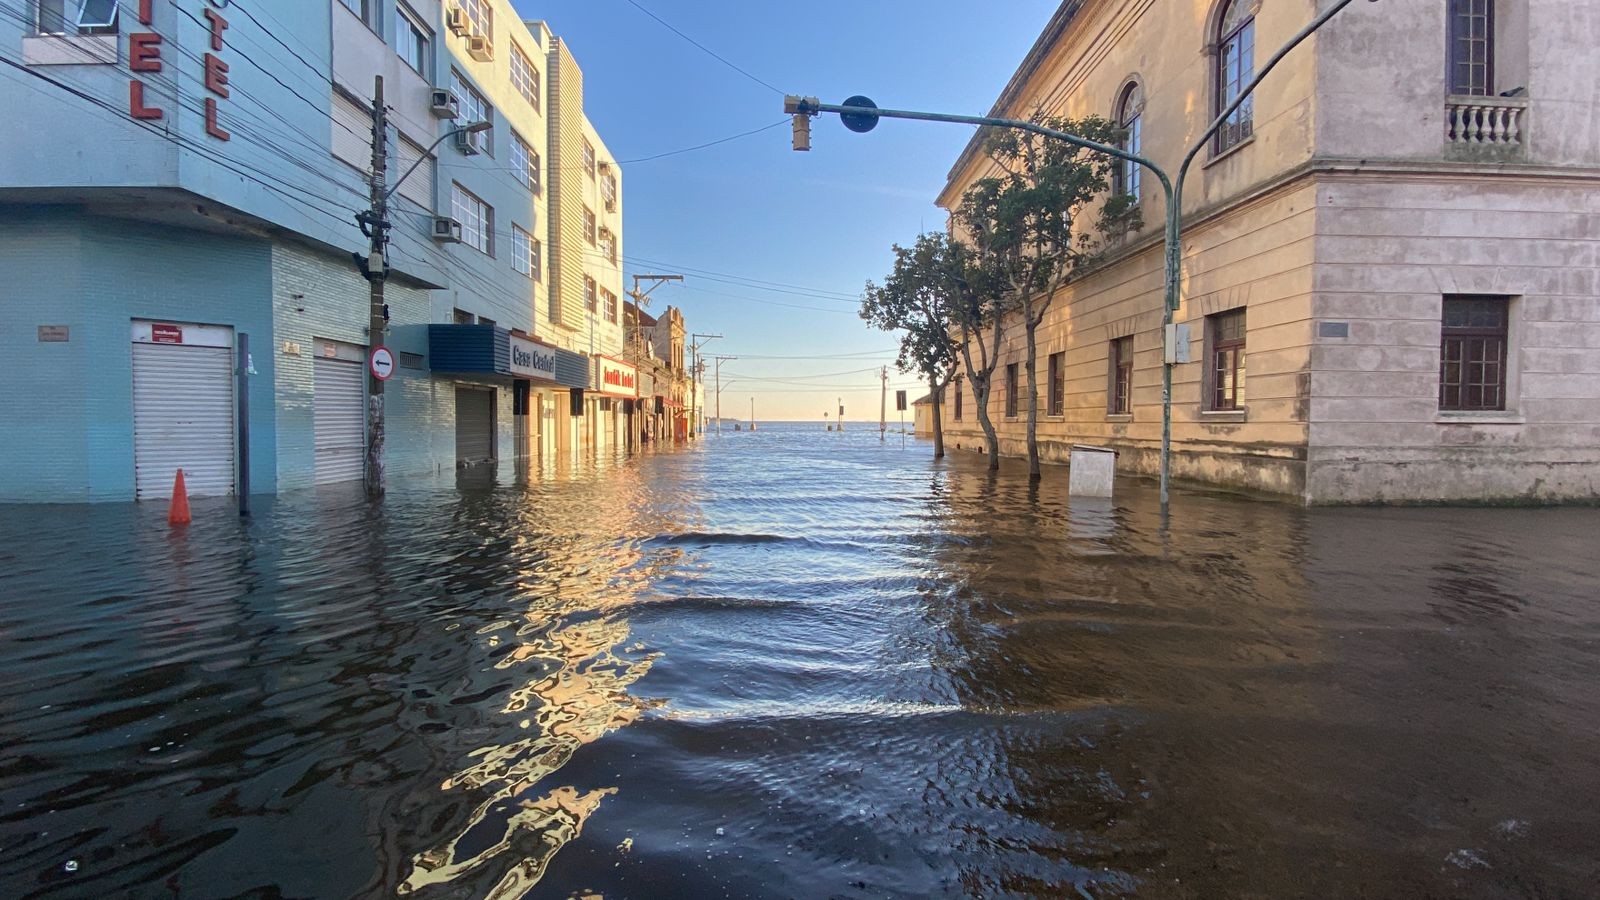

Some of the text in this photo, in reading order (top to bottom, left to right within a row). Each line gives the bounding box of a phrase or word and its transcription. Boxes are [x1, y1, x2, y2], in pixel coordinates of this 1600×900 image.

[204, 0, 230, 141] TEL
[513, 345, 554, 373] Casa Central
